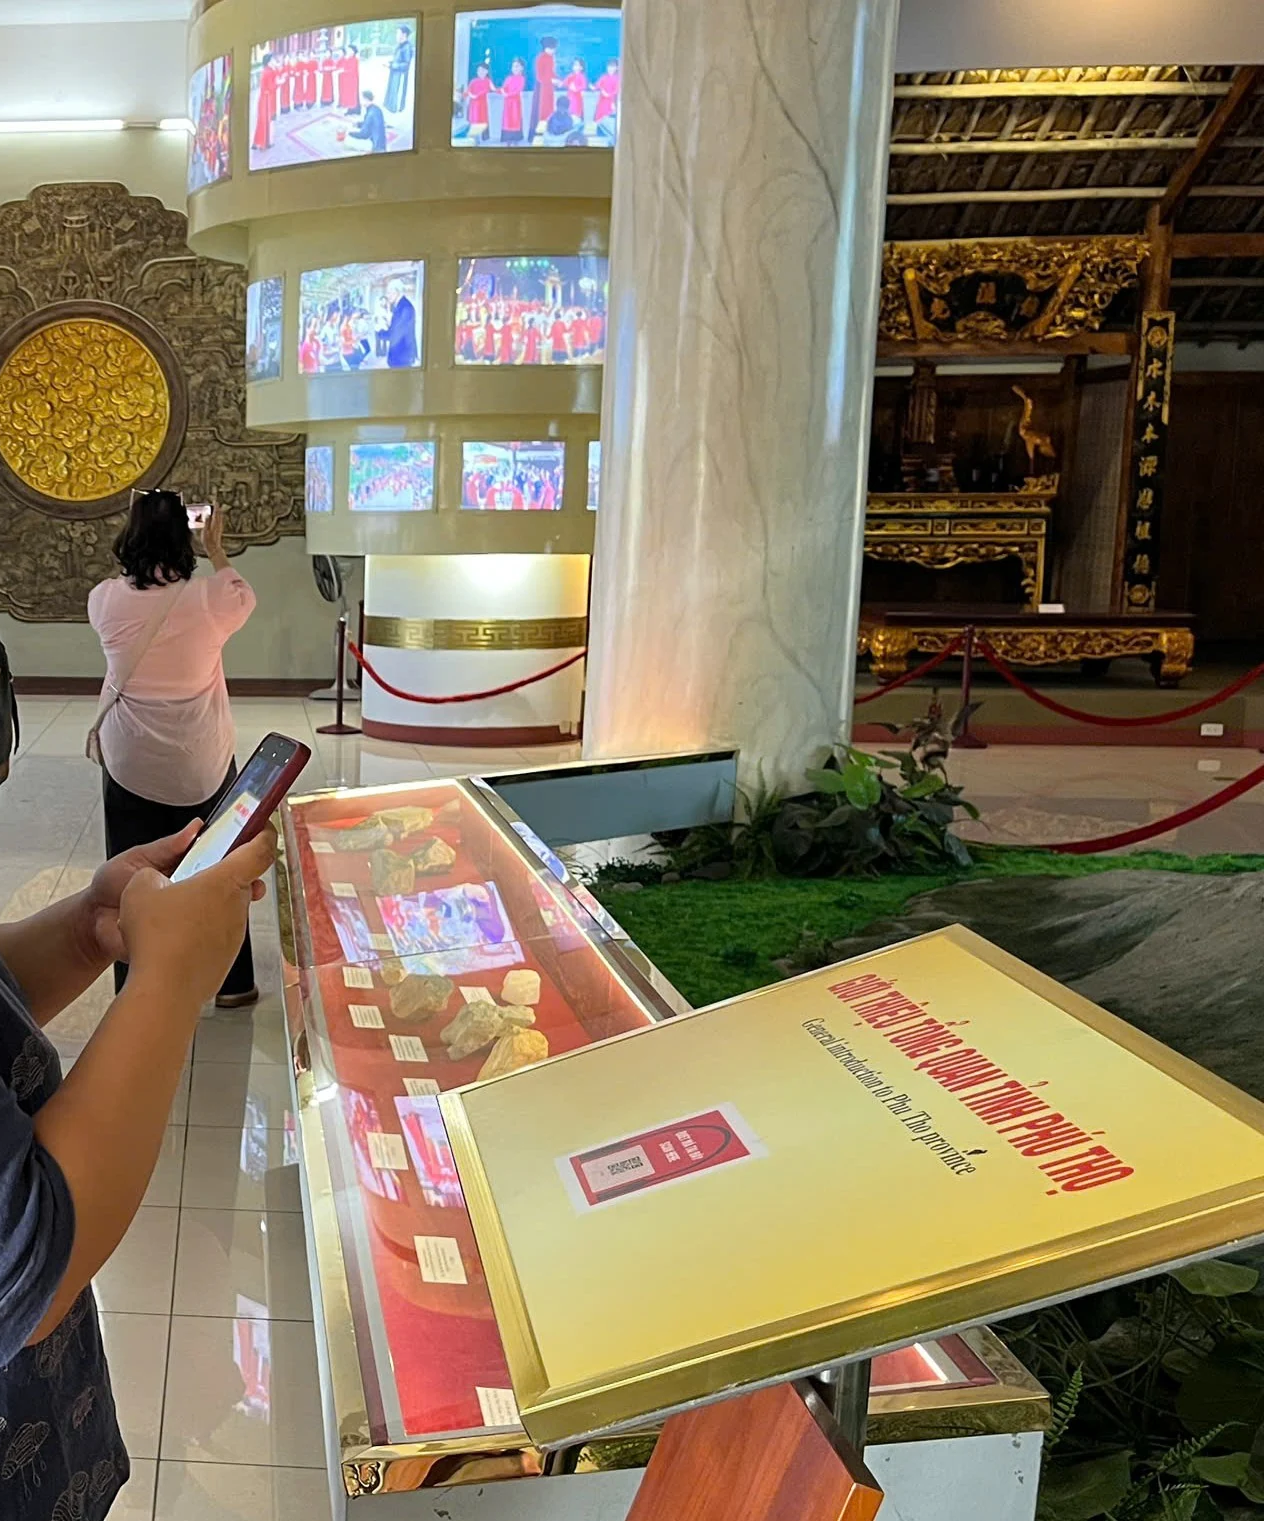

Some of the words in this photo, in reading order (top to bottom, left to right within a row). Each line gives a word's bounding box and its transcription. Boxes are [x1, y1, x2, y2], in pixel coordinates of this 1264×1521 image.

[827, 974, 898, 1003] GIỚI
[850, 991, 930, 1029] THIỆU
[802, 1017, 845, 1047] General
[883, 1017, 970, 1059] TỔNG
[826, 1041, 884, 1089] introduction
[913, 1048, 1008, 1093] QUAN
[871, 1085, 894, 1099] to
[880, 1093, 913, 1116] Phu
[958, 1079, 1051, 1125] TỈNH
[900, 1110, 933, 1135] Tho
[996, 1112, 1106, 1157] PHÚ
[911, 1131, 977, 1176] province
[1038, 1145, 1135, 1196] THỌ
